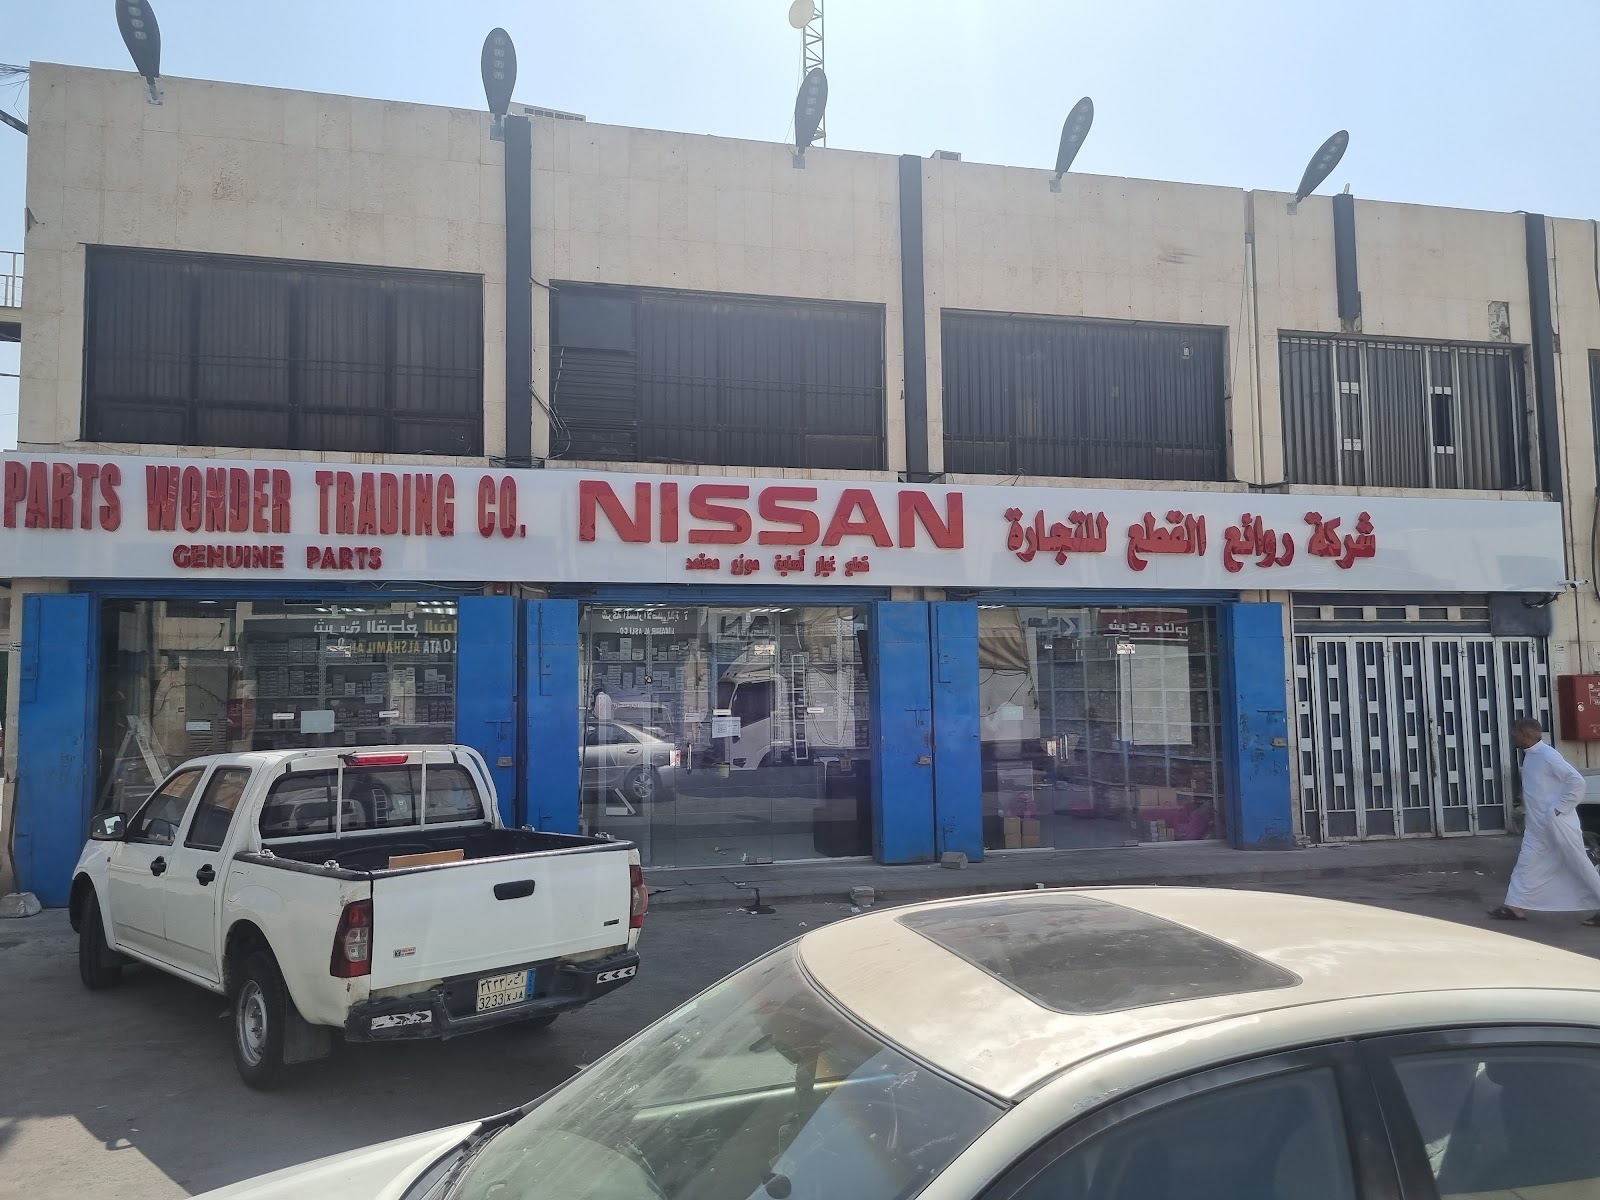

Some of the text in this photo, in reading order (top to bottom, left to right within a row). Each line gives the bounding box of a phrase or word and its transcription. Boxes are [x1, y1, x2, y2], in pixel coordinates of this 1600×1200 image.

[3, 460, 526, 540] PARTS WONDER TRADING CO.
[578, 479, 965, 549] NISSAN
[1003, 506, 1376, 574] شركة روائع القطع للتجارة
[172, 543, 383, 571] GENUINE PARTS
[685, 552, 720, 571] معتمد
[774, 549, 806, 577] أصلية
[814, 555, 836, 577] غيار
[844, 555, 870, 577] قطع
[479, 993, 504, 1010] 3233
